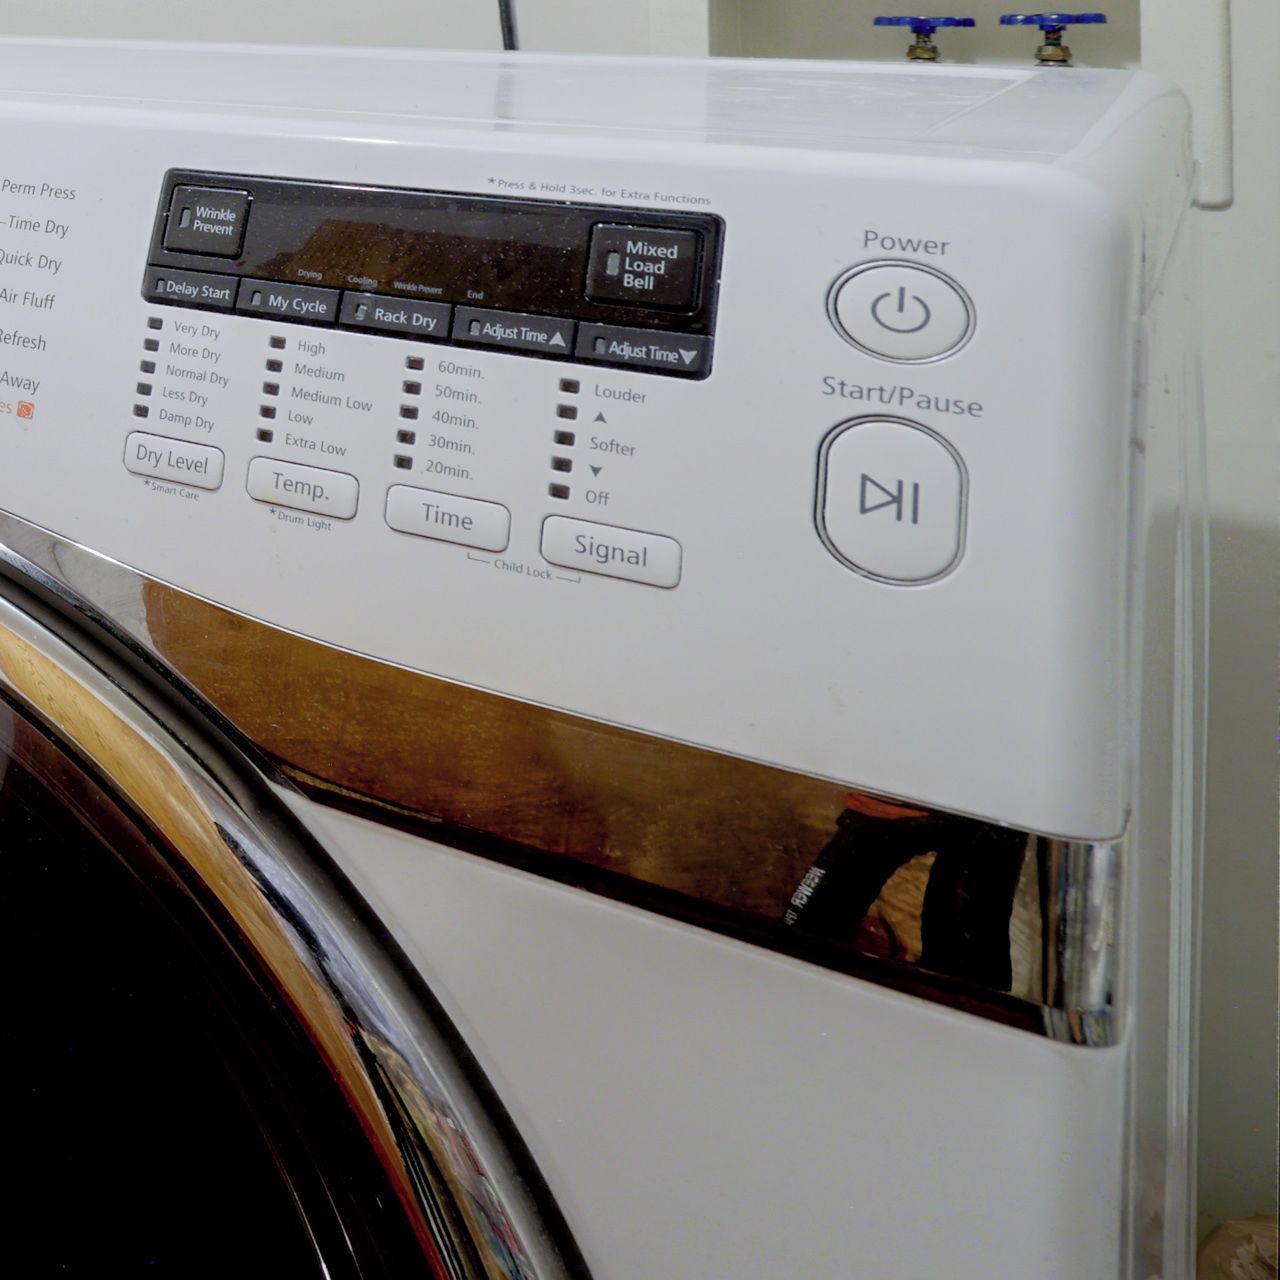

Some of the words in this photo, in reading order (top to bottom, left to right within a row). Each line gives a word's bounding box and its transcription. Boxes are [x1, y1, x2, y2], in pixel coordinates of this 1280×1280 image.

[1, 178, 36, 197] Perm
[40, 183, 77, 201] Press
[497, 178, 525, 191] Press
[529, 181, 537, 191] &
[540, 182, 566, 195] Hold
[569, 184, 598, 197] 3sec.
[601, 186, 618, 198] for
[621, 188, 651, 202] Extra
[653, 191, 712, 207] Functions
[195, 205, 237, 222] Wrinkle
[8, 215, 41, 233] Time
[44, 219, 70, 240] Dry
[192, 220, 234, 237] Prevent
[626, 240, 679, 261] Mixed
[864, 229, 951, 256] Power
[38, 254, 63, 273] Dry
[297, 268, 323, 281] Drying
[624, 257, 666, 276] Load
[166, 280, 200, 298] Delay
[201, 285, 230, 300] Start
[347, 274, 379, 288] Cooling
[393, 281, 417, 292] Wrinkle
[417, 284, 442, 295] Prevent
[623, 273, 655, 291] Bell
[22, 291, 57, 311] Fluff
[268, 294, 289, 311] My
[292, 297, 327, 315] Cycle
[466, 289, 484, 300] End
[173, 320, 200, 338] Very
[201, 324, 221, 341] Dry
[374, 307, 408, 326] Rack
[412, 312, 438, 332] Dry
[481, 322, 519, 342] Adjust
[520, 326, 548, 344] Time
[169, 342, 199, 359] More
[202, 347, 221, 363] Dry
[297, 339, 326, 356] High
[608, 341, 647, 361] Adjust
[647, 345, 679, 364] Time
[165, 364, 207, 383] Normal
[209, 371, 230, 389] Dry
[294, 363, 346, 383] Medium
[437, 360, 485, 380] 60min.
[0, 370, 40, 396] Away
[594, 383, 647, 405] Louder
[162, 386, 186, 402] Less
[188, 390, 209, 408] Dry
[291, 386, 342, 407] Medium
[345, 395, 374, 412] Low
[434, 384, 482, 405] 50min.
[821, 375, 984, 418] Start/Pause
[158, 408, 192, 428] Damp
[195, 415, 215, 434] Dry
[287, 409, 314, 426] Low
[431, 409, 480, 431] 40min.
[284, 432, 317, 451] Extra
[319, 439, 347, 457] Low
[427, 433, 476, 456] 30min.
[589, 436, 637, 458] Softer
[135, 443, 163, 468] Dry
[166, 450, 210, 476] Level
[424, 459, 474, 482] 20min.
[151, 481, 178, 497] Smart
[178, 486, 201, 502] Care
[272, 471, 331, 502] Temp.
[585, 489, 610, 507] Off
[277, 510, 305, 526] Drum
[306, 515, 333, 533] Light
[422, 502, 474, 532] Time
[574, 534, 648, 568] Signal
[493, 558, 525, 575] Child
[526, 564, 553, 581] Lock
